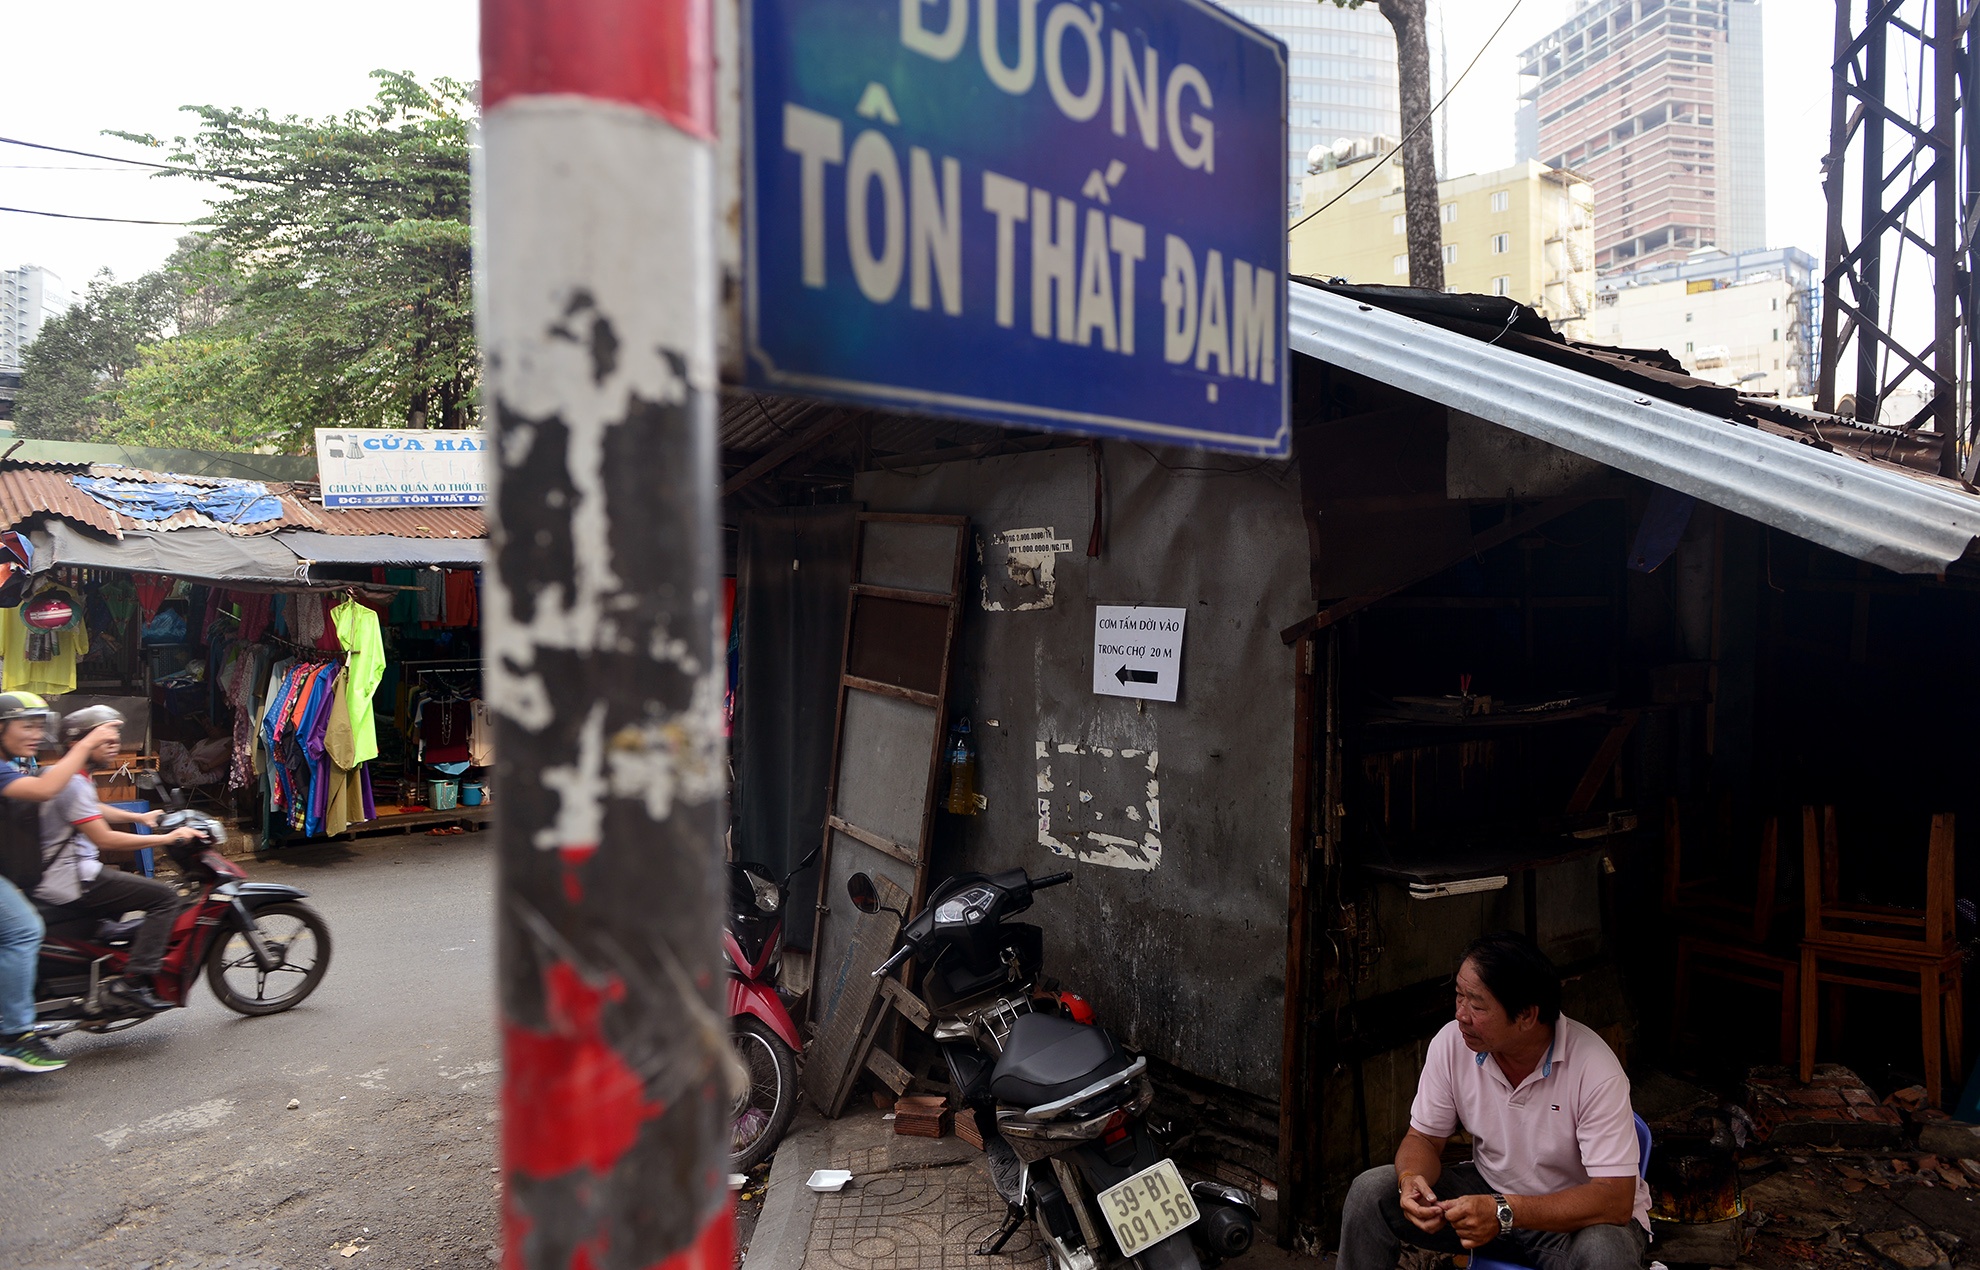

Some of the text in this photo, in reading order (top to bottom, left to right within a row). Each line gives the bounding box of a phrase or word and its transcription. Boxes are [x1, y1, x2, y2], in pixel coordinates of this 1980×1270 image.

[783, 82, 1275, 402] TÔN THẤT ĐẠM
[363, 434, 425, 451] CỬA
[475, 483, 488, 491] TR
[366, 495, 399, 503] 127E
[402, 494, 429, 502] TÔN
[432, 493, 465, 502] THẤT
[1099, 615, 1180, 632] CƠM TẤM DỜI VÀO
[1098, 643, 1172, 659] TRONG CHỢ 20 M
[1110, 1169, 1171, 1217] 59-B1
[1118, 1193, 1193, 1249] 091.56
